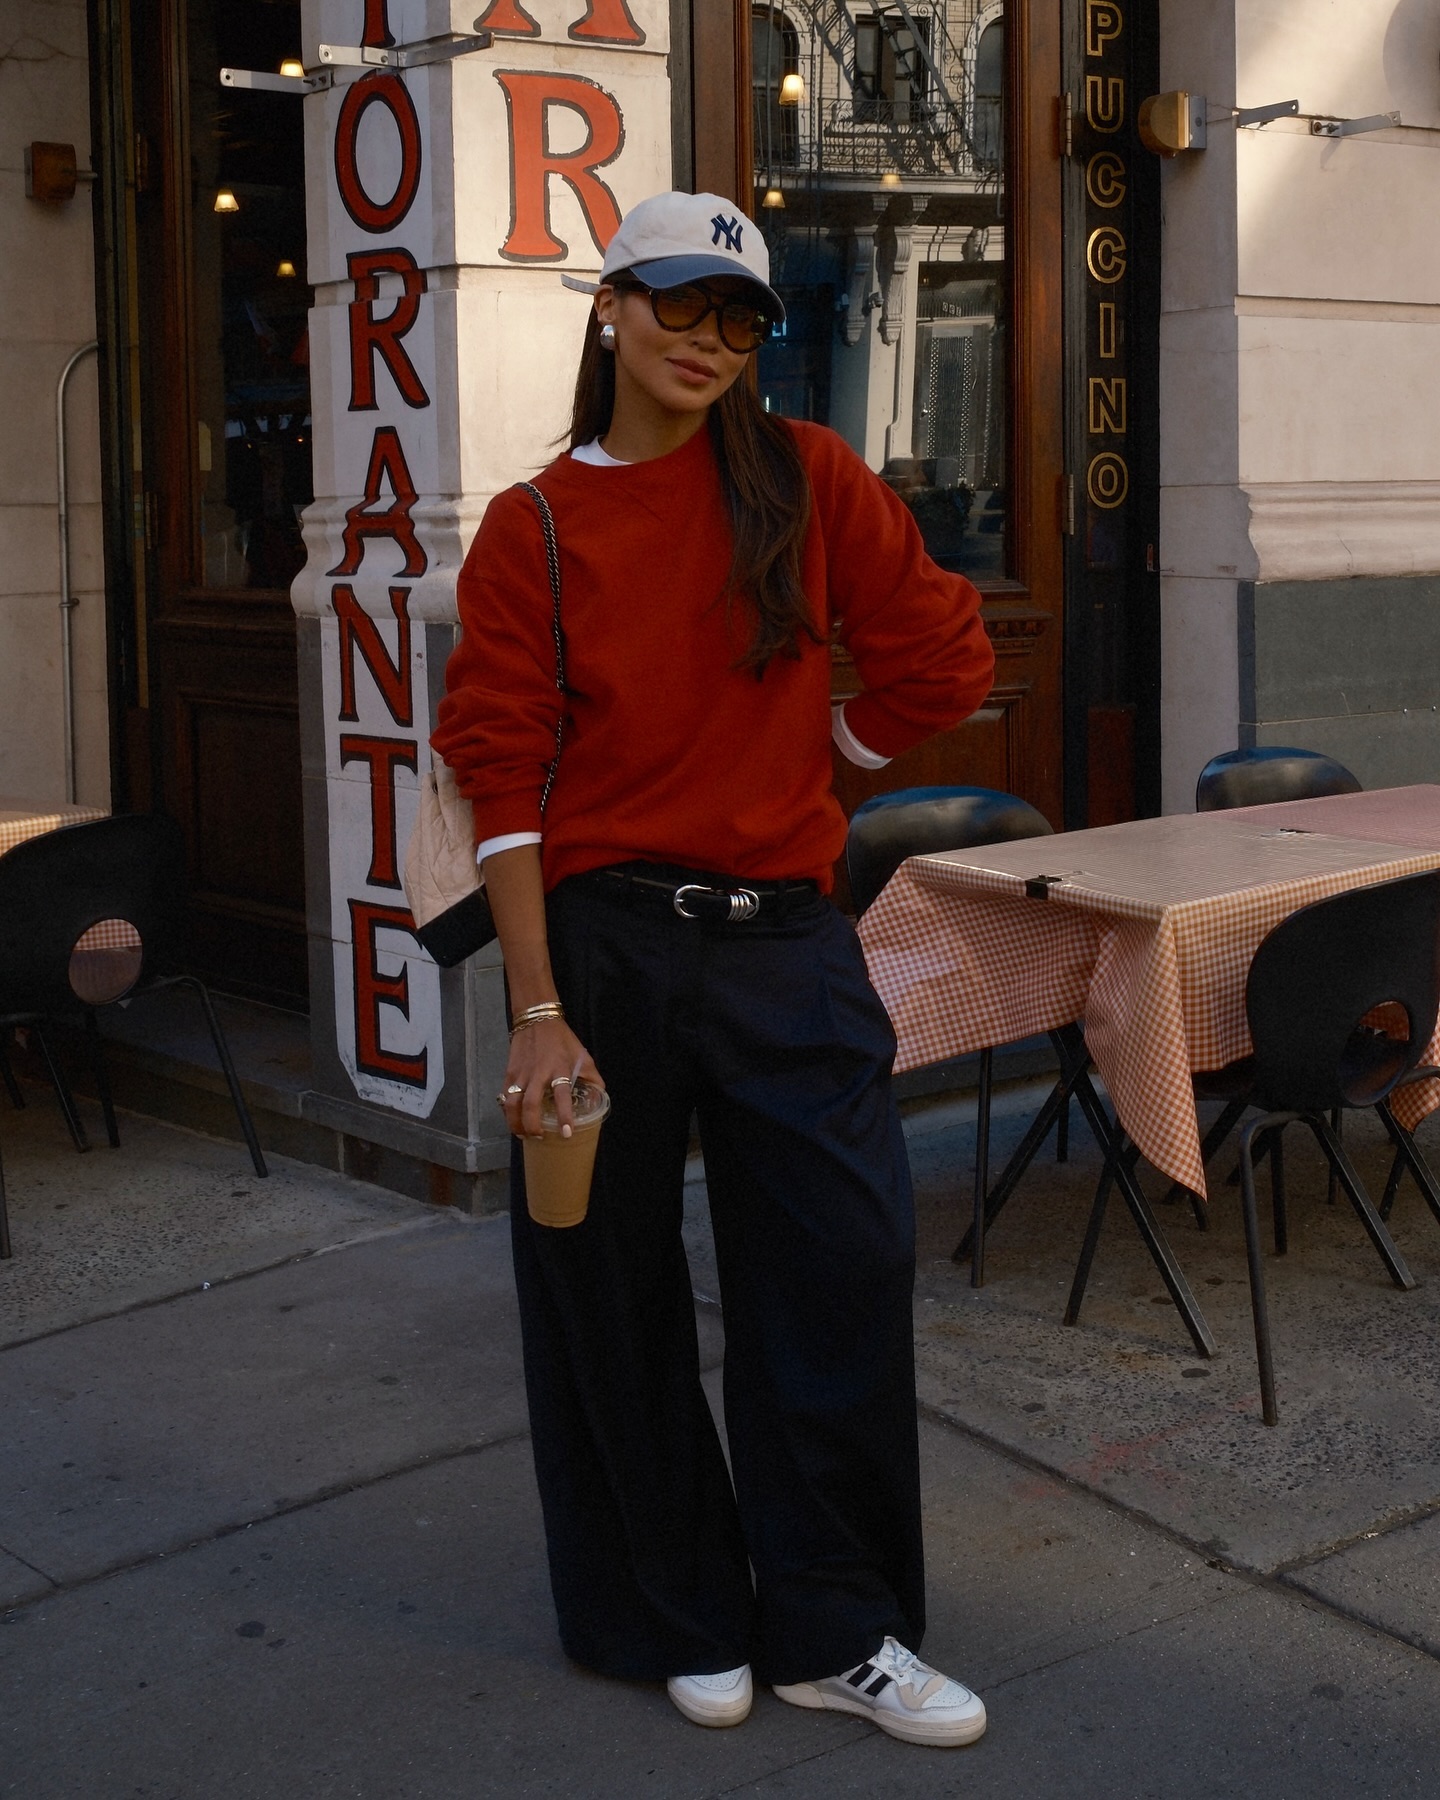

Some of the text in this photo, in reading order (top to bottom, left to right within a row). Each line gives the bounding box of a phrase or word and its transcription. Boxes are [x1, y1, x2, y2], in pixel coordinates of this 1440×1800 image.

[473, 0, 646, 263] R
[710, 213, 744, 254] NY
[1086, 0, 1128, 509] PUCCINO
[325, 0, 431, 1089] ORANTE
